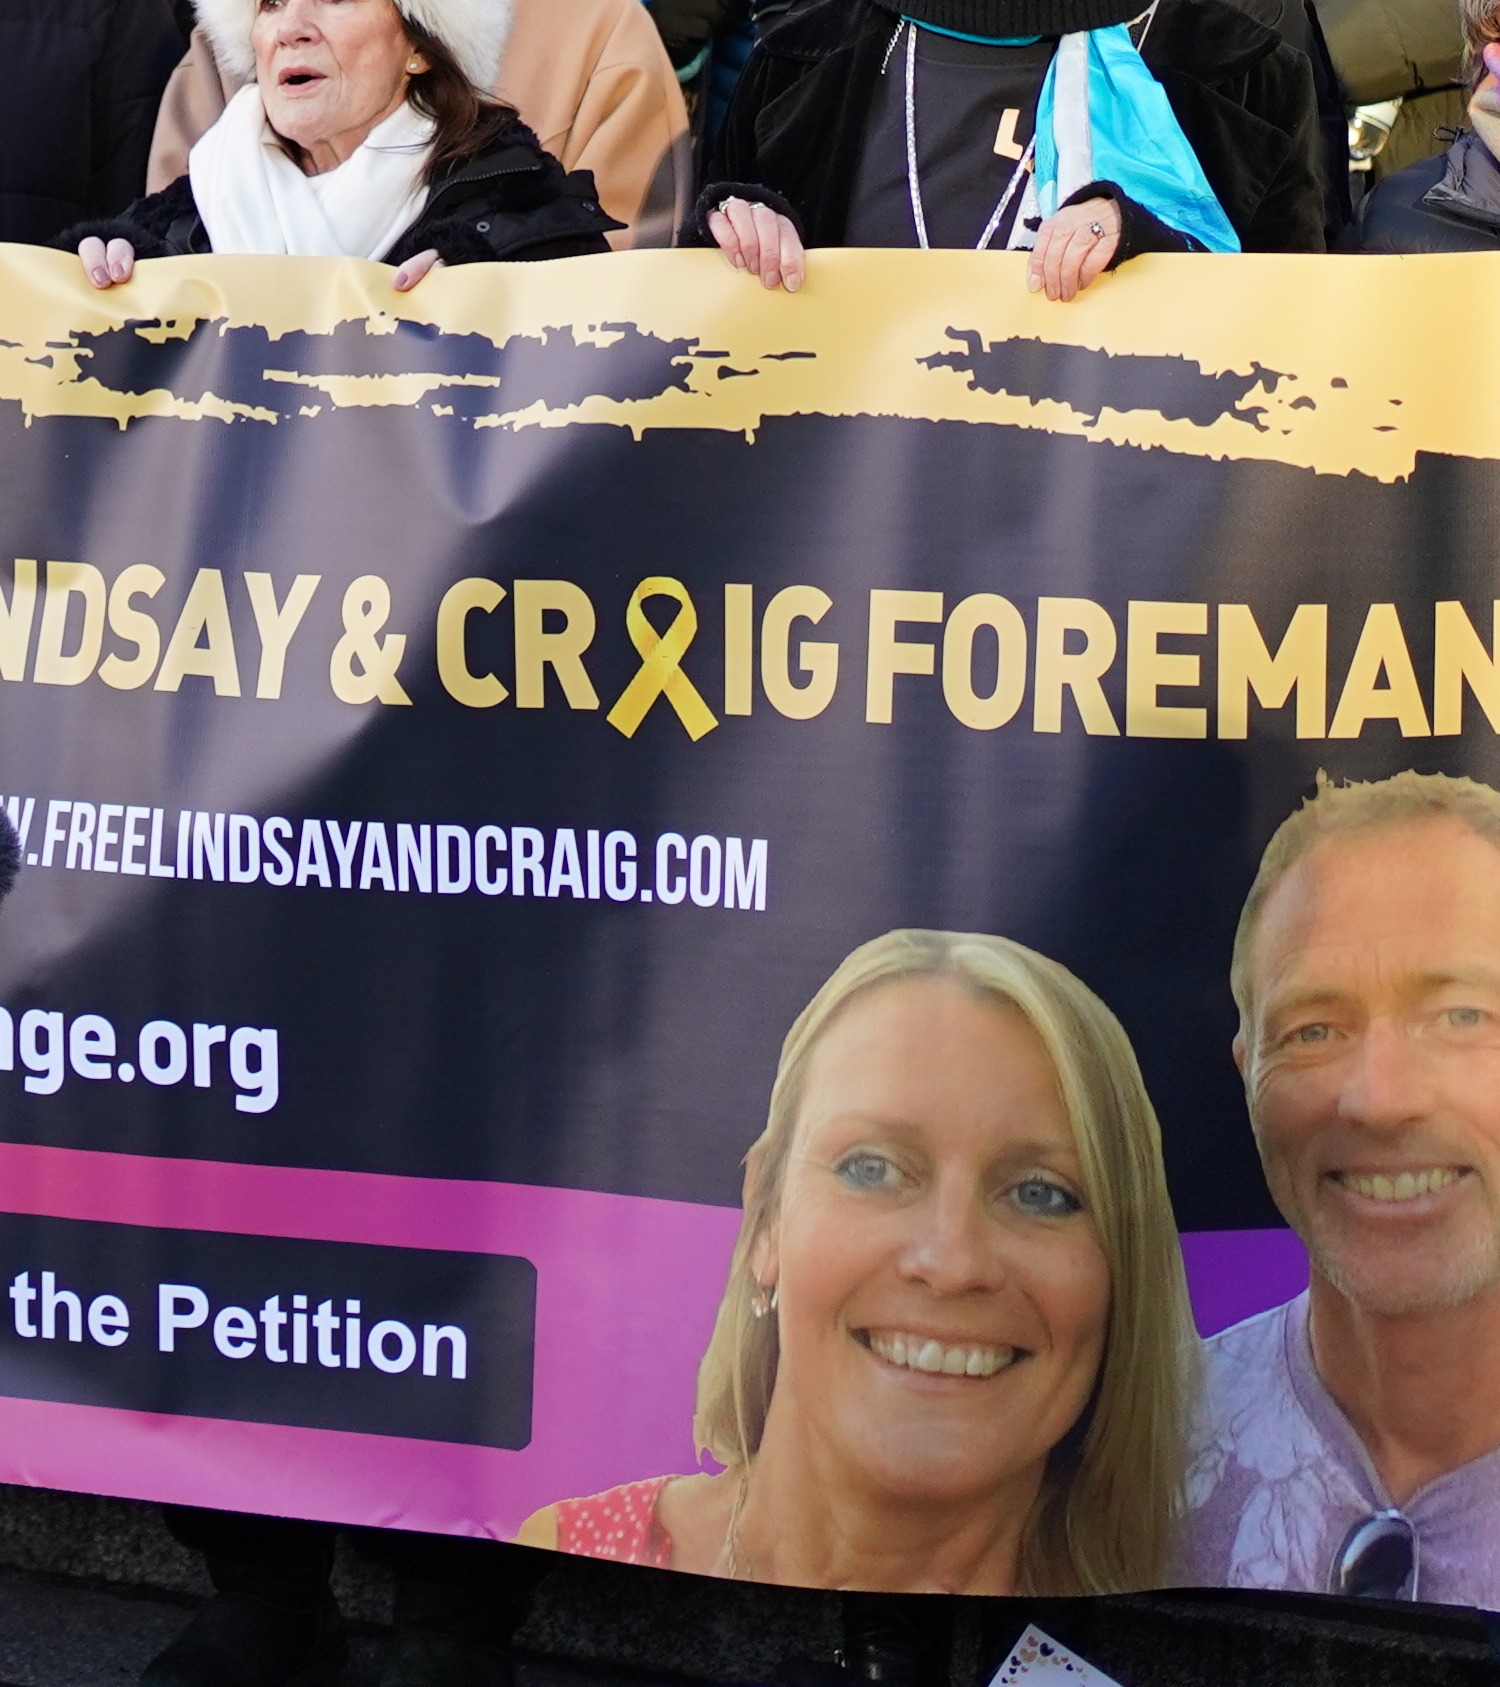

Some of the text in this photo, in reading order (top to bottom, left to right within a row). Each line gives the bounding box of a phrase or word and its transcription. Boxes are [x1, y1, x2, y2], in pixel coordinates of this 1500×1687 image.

[328, 574, 412, 707] &
[9, 1271, 130, 1347] the
[158, 1283, 468, 1380] Petition
